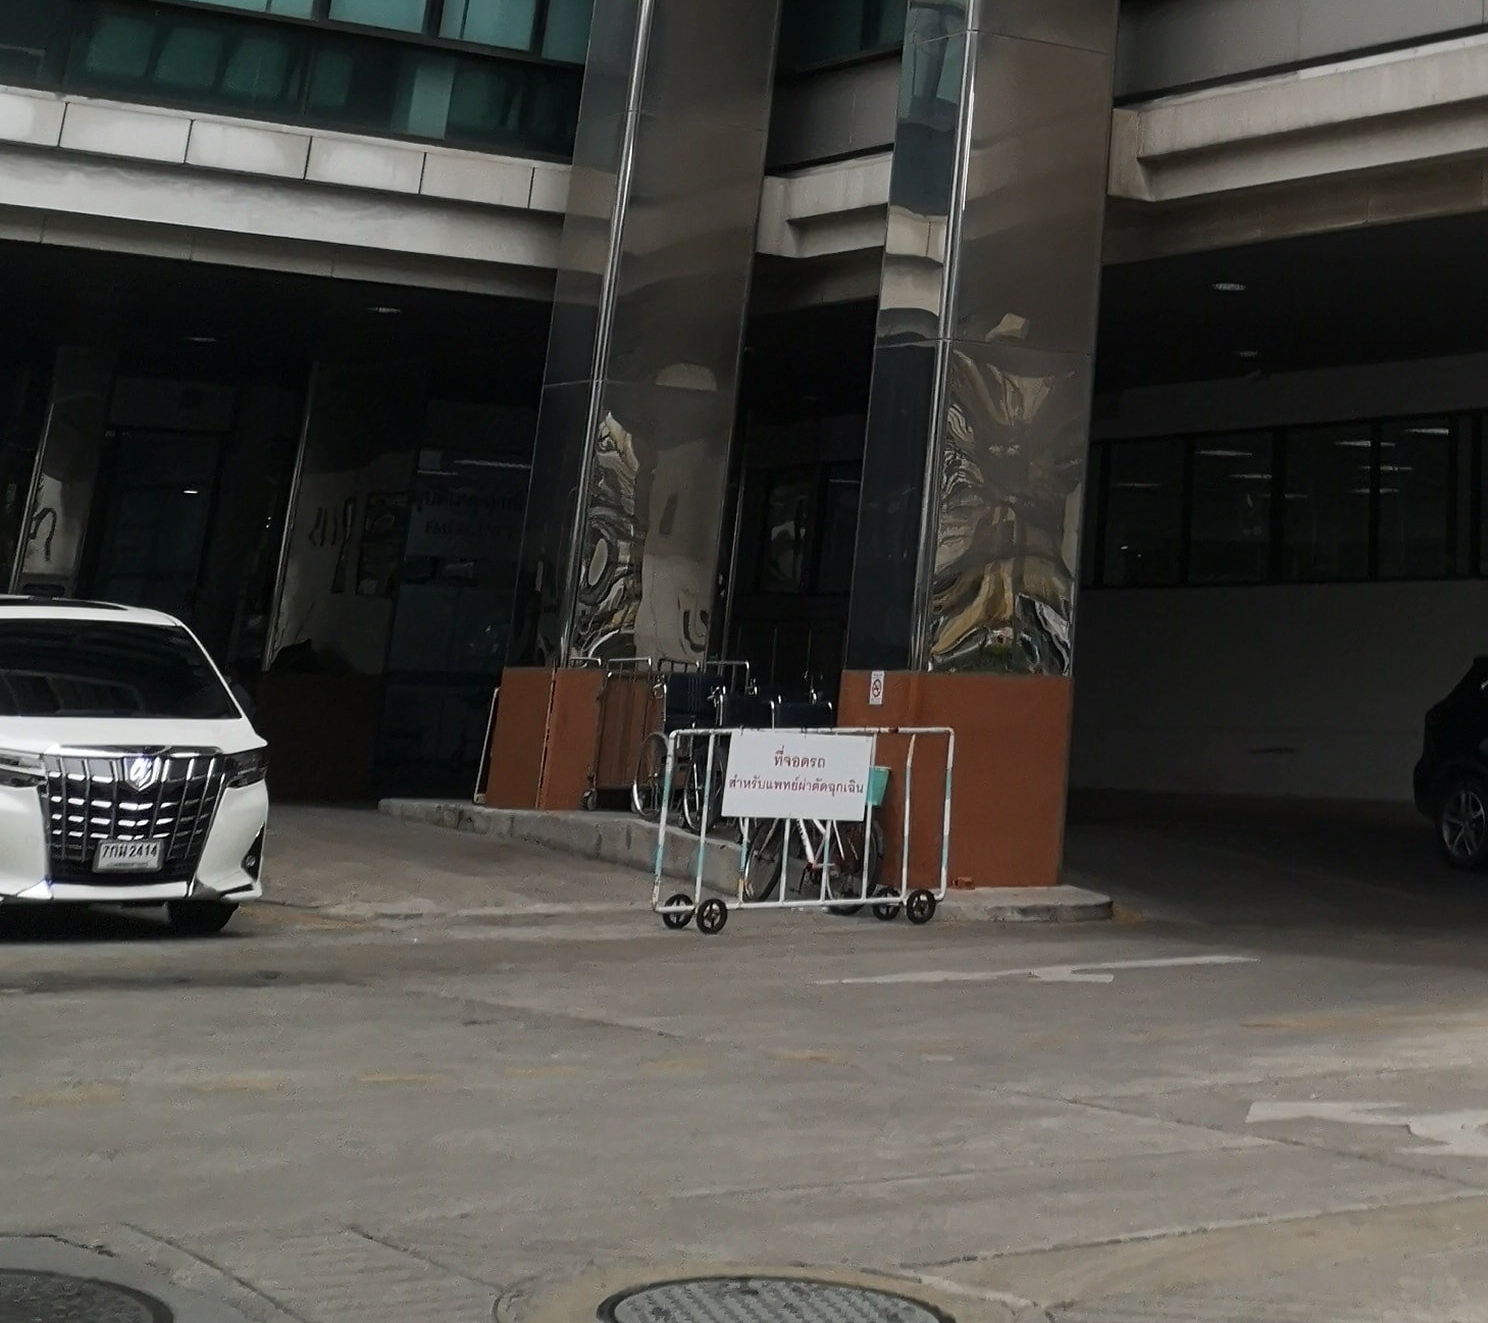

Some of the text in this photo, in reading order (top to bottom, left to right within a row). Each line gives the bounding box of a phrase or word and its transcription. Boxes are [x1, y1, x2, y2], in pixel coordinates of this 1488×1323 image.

[774, 745, 826, 769] ที่จอดรถ
[129, 843, 158, 858] 2414
